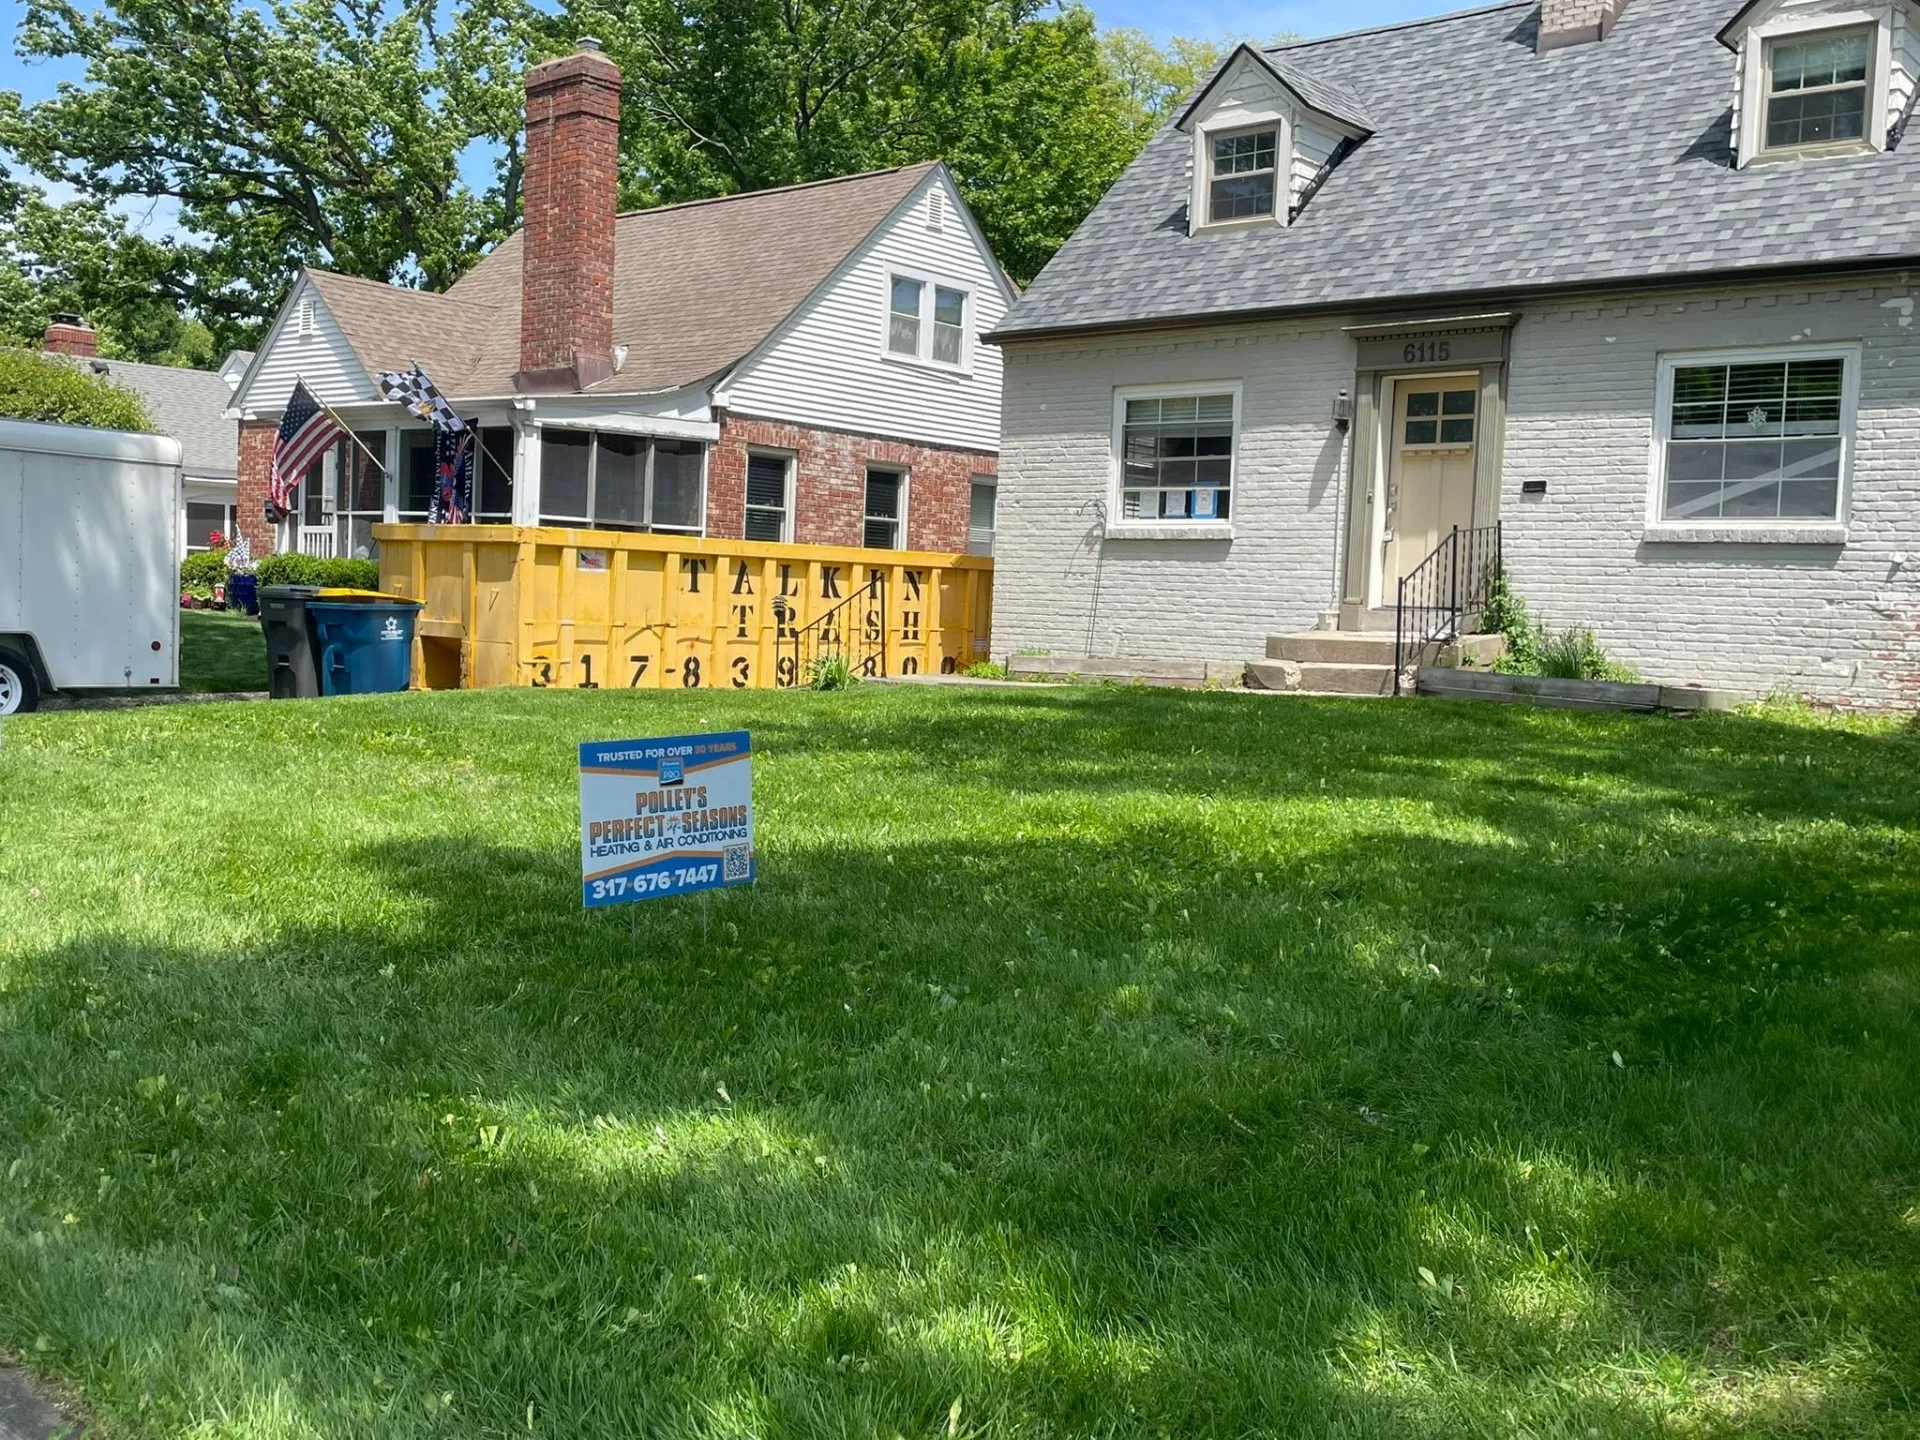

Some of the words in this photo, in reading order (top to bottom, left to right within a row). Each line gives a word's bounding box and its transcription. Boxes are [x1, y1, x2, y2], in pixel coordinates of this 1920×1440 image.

[1403, 341, 1450, 363] 6115
[682, 557, 923, 601] TALKIN
[732, 604, 921, 641] TRASH
[597, 748, 643, 762] TRUSTED
[645, 748, 665, 759] FOR
[667, 746, 693, 757] OVER
[708, 742, 737, 753] YEARS
[635, 786, 708, 815] POLLEY'S
[589, 815, 665, 845] PERFECT
[681, 805, 747, 834] SEASONS
[590, 842, 640, 858] HEATING
[644, 840, 653, 850] &
[656, 837, 674, 850] AIR
[678, 828, 748, 845] CONDITIONING
[592, 864, 718, 899] 317-676-7447
